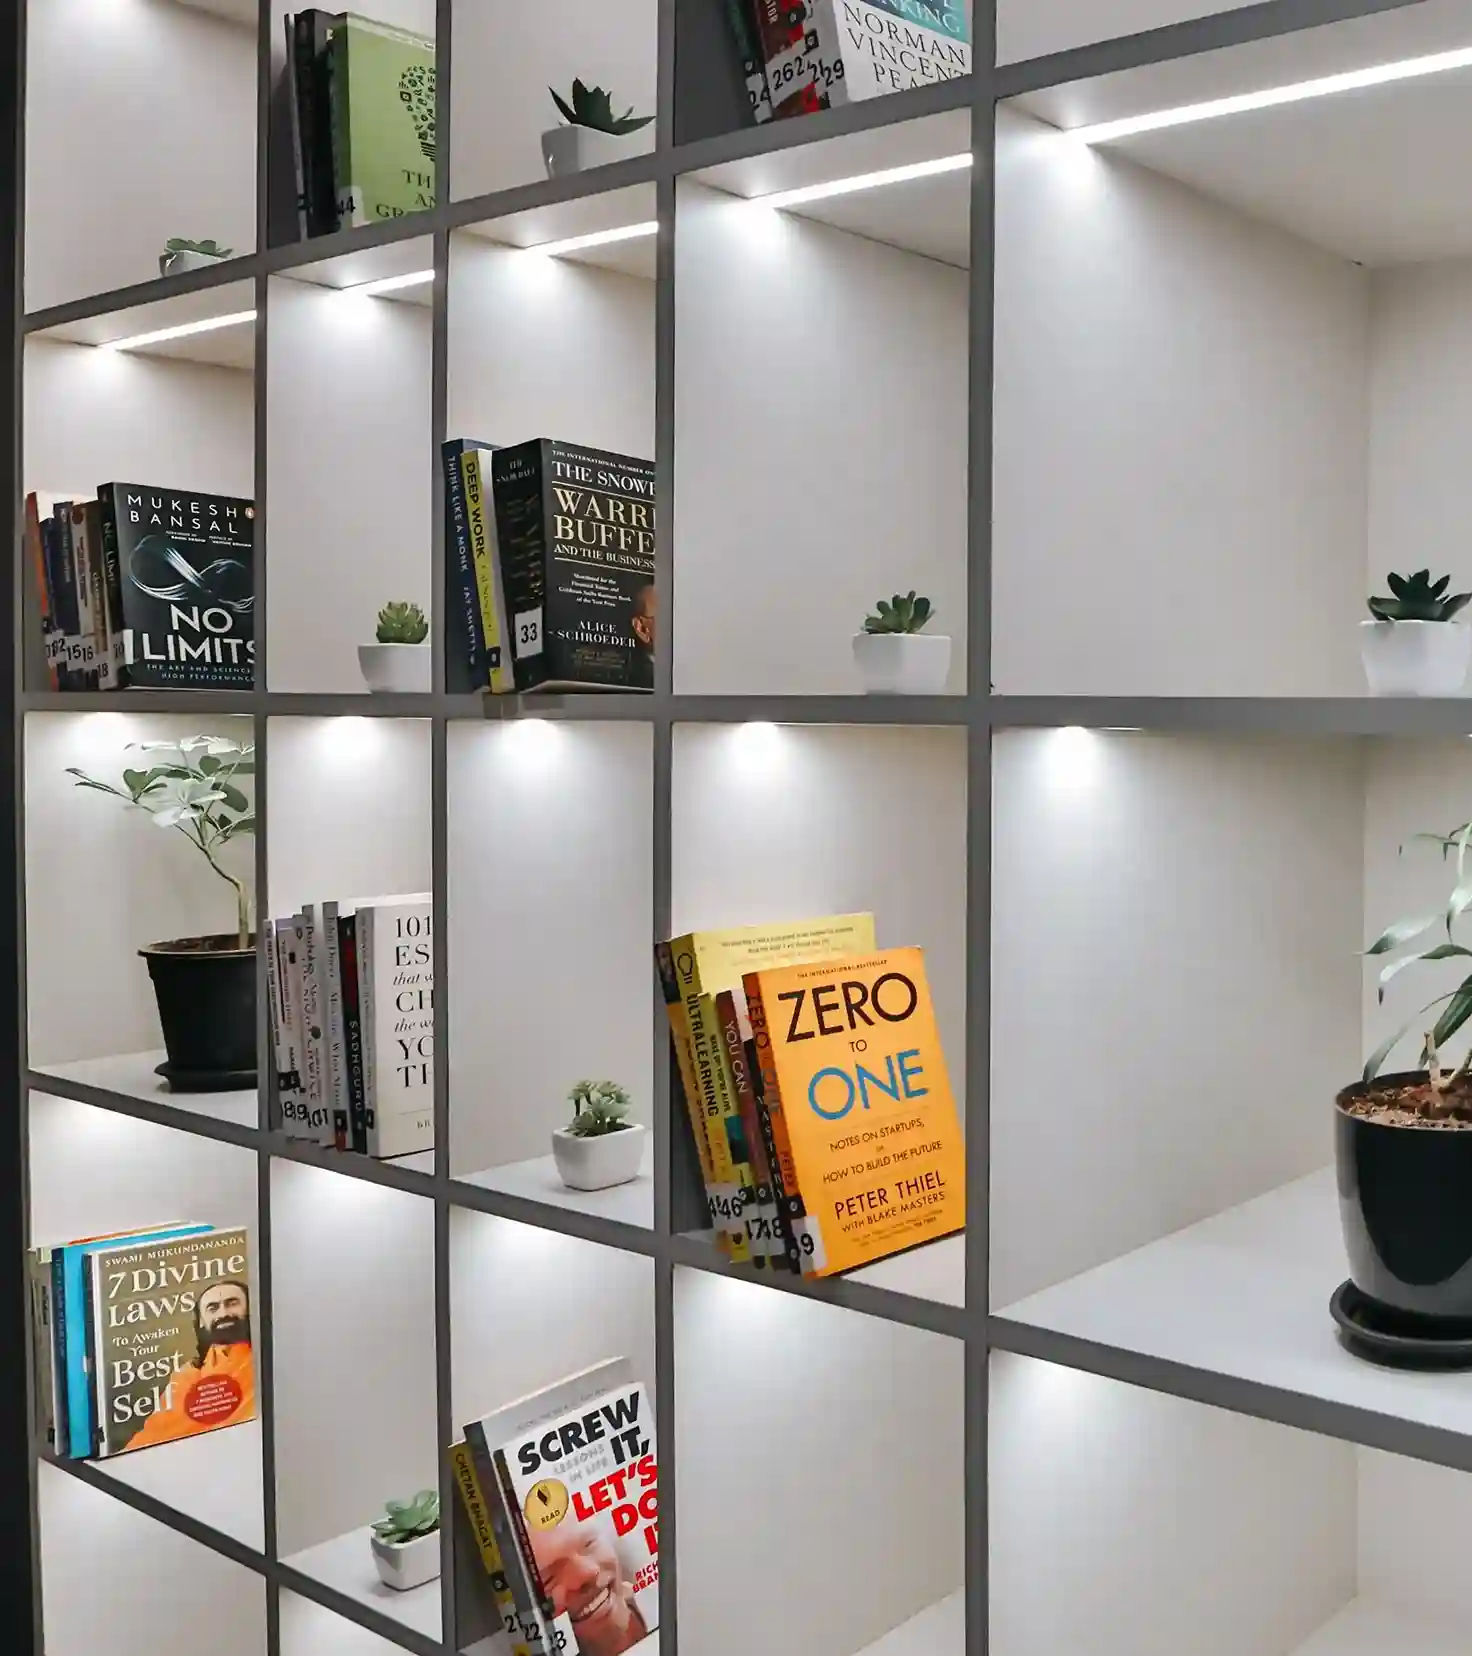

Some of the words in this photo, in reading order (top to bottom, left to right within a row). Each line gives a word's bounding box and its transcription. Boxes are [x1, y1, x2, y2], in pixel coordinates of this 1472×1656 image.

[842, 2, 966, 68] NORMAN
[846, 27, 964, 80] VINCEN
[772, 62, 794, 91] 26
[823, 58, 846, 88] 29
[466, 462, 480, 504] DEEP
[552, 461, 593, 483] THE
[127, 494, 237, 518] MUKESH
[130, 511, 238, 534] BANSAL
[552, 487, 656, 530] WARR
[471, 508, 486, 559] WORK
[553, 514, 656, 556] BUFFE
[554, 544, 579, 556] AND
[580, 547, 603, 560] THE
[605, 552, 656, 569] BUSINESS
[170, 603, 233, 634] NO
[520, 622, 539, 645] 33
[578, 620, 617, 634] ALICE
[556, 629, 637, 649] SCHROEDER
[395, 915, 431, 939] 101
[395, 943, 431, 967] ES
[392, 971, 421, 986] that
[394, 1017, 416, 1033] the
[777, 972, 918, 1044] ZERO
[686, 992, 720, 1117] ULTRALEARNING
[724, 1019, 740, 1056] YOU
[732, 1059, 749, 1094] CAN
[849, 1039, 868, 1053] TO
[349, 1020, 367, 1112] SADHGURU
[807, 1048, 930, 1121] ONE
[829, 1135, 861, 1153] NOTES
[861, 1131, 878, 1143] ON
[879, 1117, 926, 1138] STARTUPS,
[822, 1167, 849, 1184] HOW
[850, 1163, 865, 1175] TO
[866, 1155, 892, 1171] BUILD
[891, 1148, 909, 1164] THE
[909, 1140, 943, 1158] FUTURE
[834, 1187, 889, 1221] PETER
[894, 1169, 946, 1200] THIEL
[841, 1219, 866, 1233] WITH
[866, 1206, 897, 1225] BLAKE
[900, 1190, 946, 1213] MASTERS
[104, 1252, 143, 1268] SWAMI
[146, 1236, 246, 1261] MUKUNDANANDA
[107, 1270, 127, 1299] 7
[131, 1253, 246, 1293] Divine
[108, 1290, 196, 1328] Laws
[112, 1335, 129, 1347] To
[131, 1327, 180, 1344] Awaken
[129, 1344, 160, 1357] Your
[111, 1350, 185, 1389] Best
[112, 1380, 179, 1424] Self
[517, 1390, 640, 1476] SCREW
[610, 1425, 651, 1466] IT,
[455, 1452, 477, 1500] CHETAN
[571, 1455, 659, 1523] LET'S
[540, 1509, 561, 1524] READ
